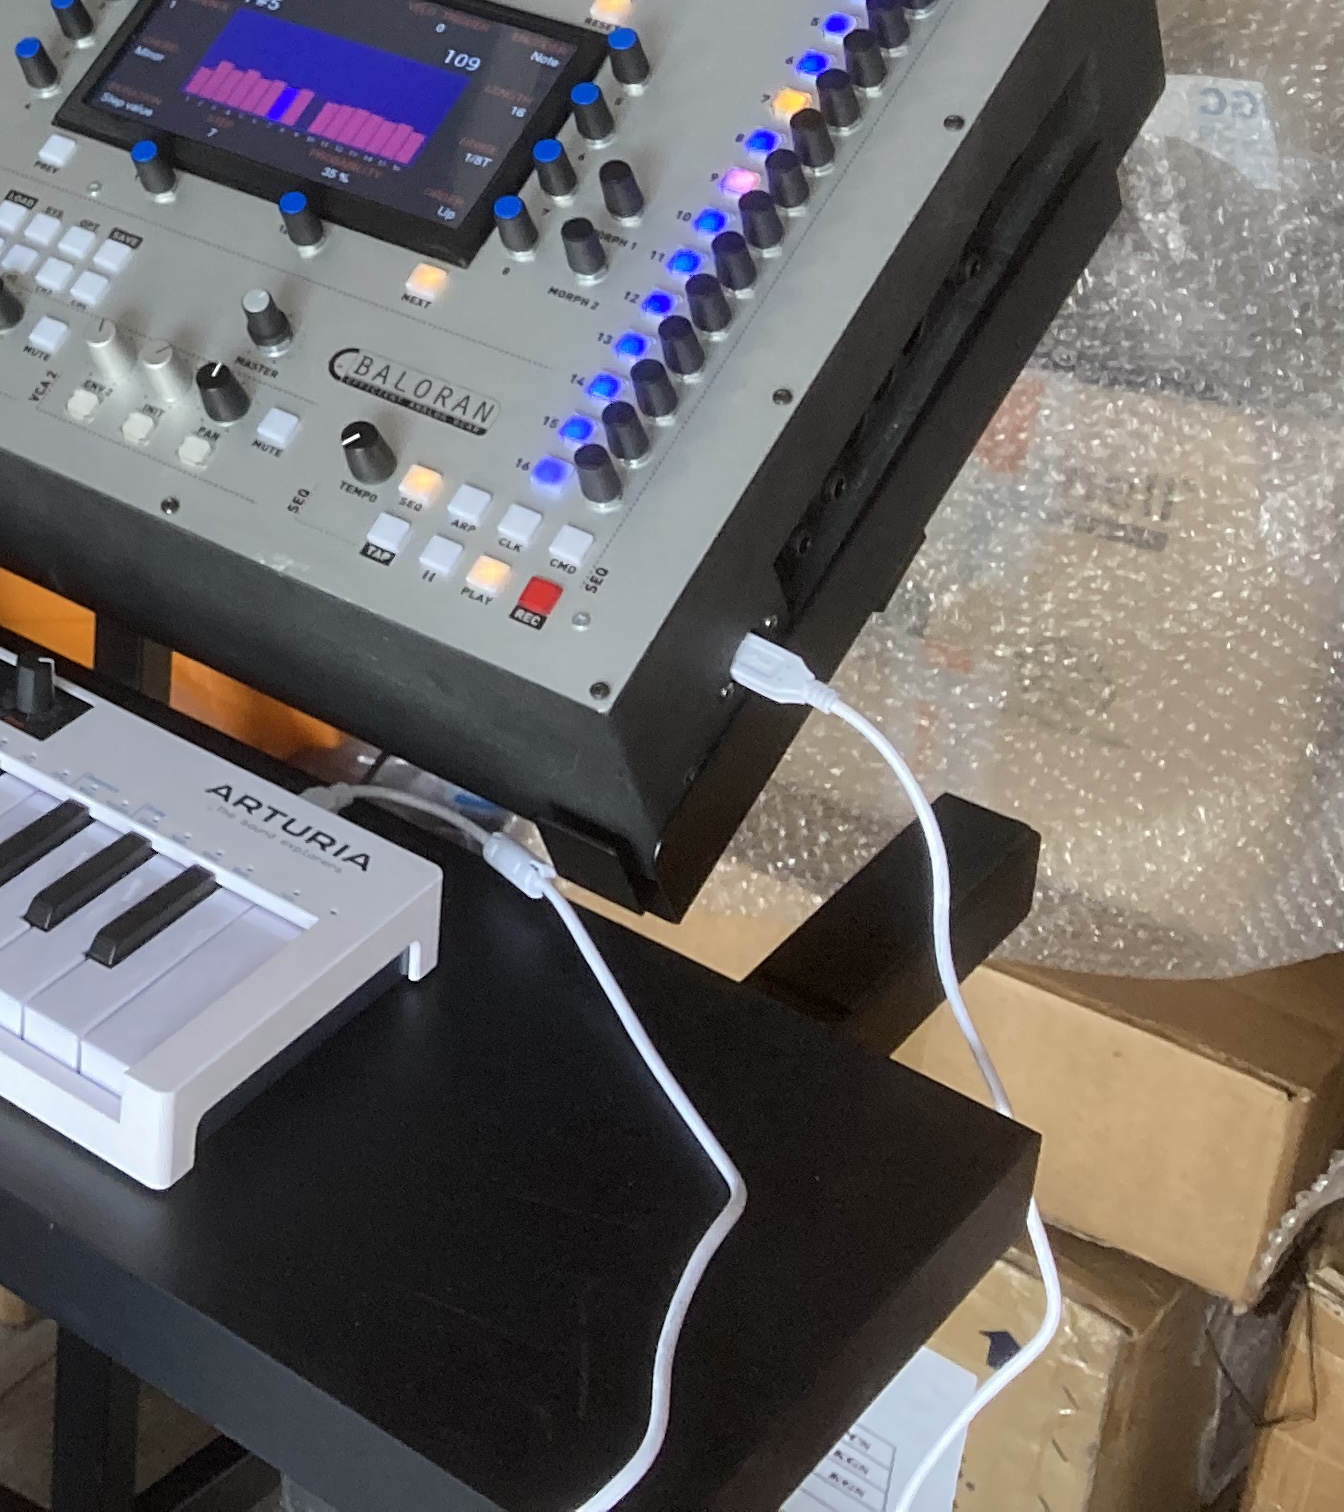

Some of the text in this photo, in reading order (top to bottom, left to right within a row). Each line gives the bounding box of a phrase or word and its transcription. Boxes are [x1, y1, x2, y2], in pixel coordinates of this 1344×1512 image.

[444, 49, 481, 72] 109
[530, 50, 560, 68] Note
[34, 160, 60, 175] PREV
[8, 191, 36, 208] LOAD
[437, 204, 456, 220] Up
[676, 210, 692, 223] 10
[80, 219, 100, 232] OPT
[113, 230, 141, 247] SAVE
[595, 229, 630, 248] ORPH
[650, 249, 665, 263] 11
[401, 293, 433, 309] NEXT
[547, 286, 589, 306] MORPH
[623, 291, 640, 305] 12
[597, 332, 614, 345] 13
[23, 345, 51, 362] MUTE
[235, 356, 279, 379] MASTER
[84, 379, 105, 393] ENV
[570, 374, 586, 387] 14
[353, 354, 495, 425] BALORAN
[142, 403, 165, 418] INIT
[542, 415, 559, 430] 15
[197, 426, 220, 441] PAN
[251, 439, 284, 458] MUTE
[514, 457, 530, 472] 16
[339, 480, 378, 503] TEMPO
[287, 488, 310, 514] SEQ
[398, 497, 423, 512] SEQ
[450, 519, 477, 533] ARP
[498, 537, 523, 552] CLK
[365, 544, 393, 563] TAP
[549, 558, 577, 575] CMD
[585, 567, 609, 594] SEQ
[461, 587, 493, 606] PLAY
[514, 607, 541, 627] REC
[205, 784, 370, 872] ARTURIA
